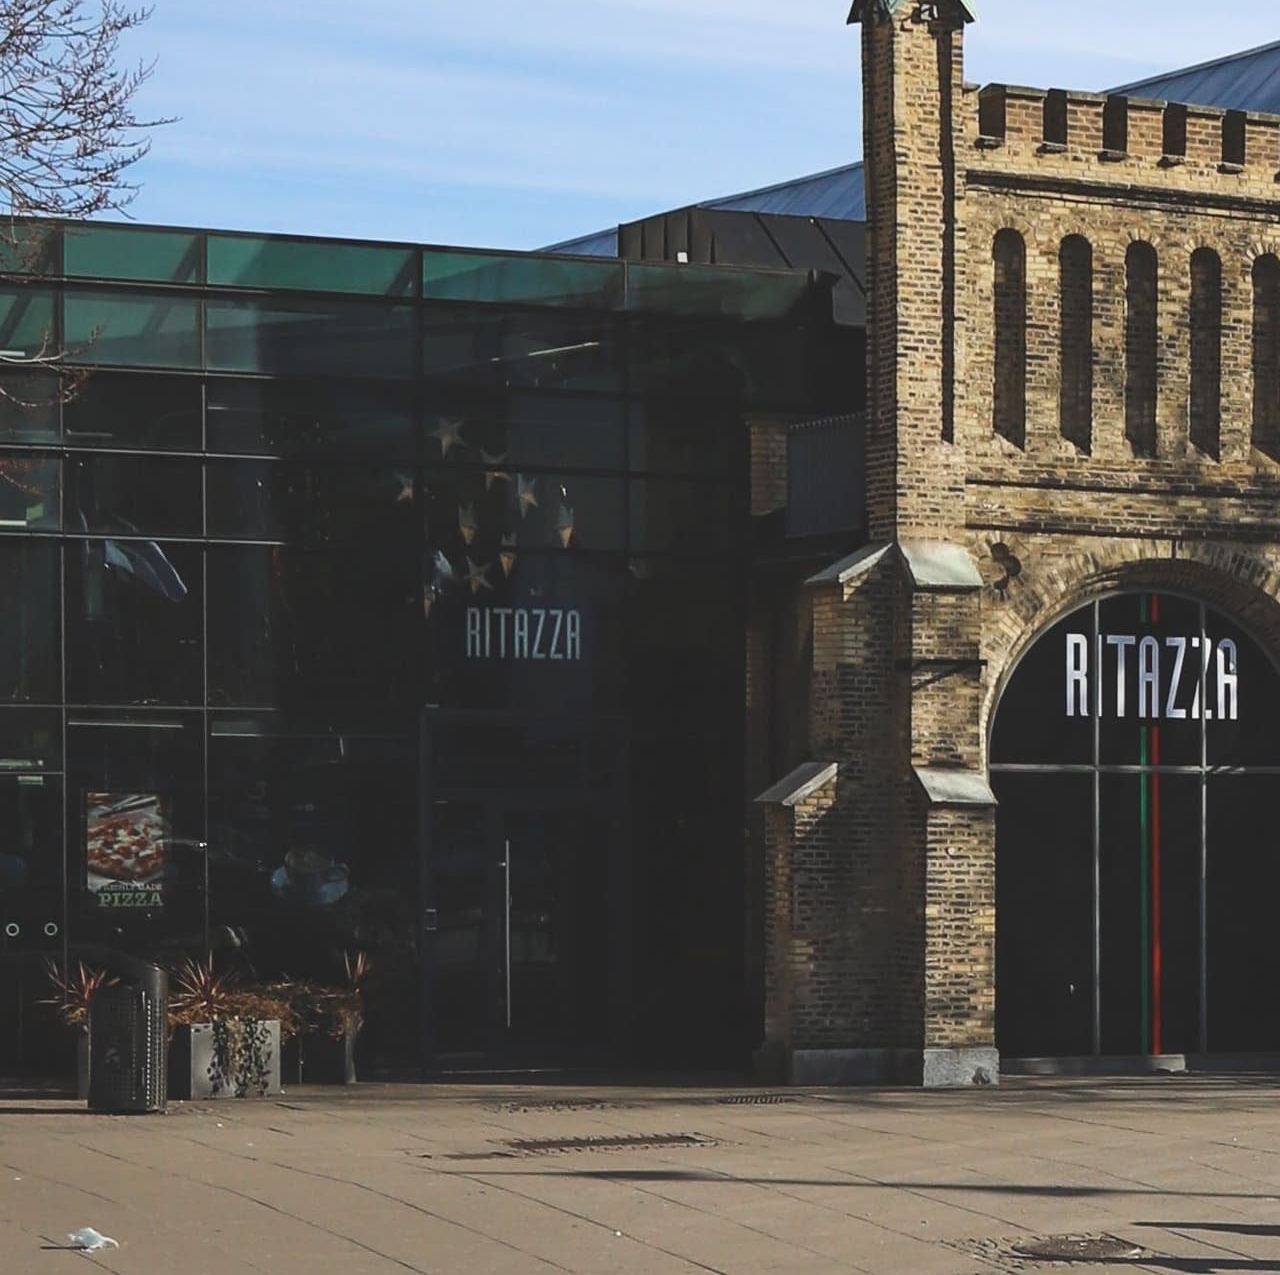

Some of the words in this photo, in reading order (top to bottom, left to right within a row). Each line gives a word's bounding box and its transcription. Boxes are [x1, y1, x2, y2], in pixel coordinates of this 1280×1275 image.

[466, 607, 582, 661] RITAZZA
[1065, 633, 1238, 720] RITAZZA
[97, 892, 164, 908] PIZZA
